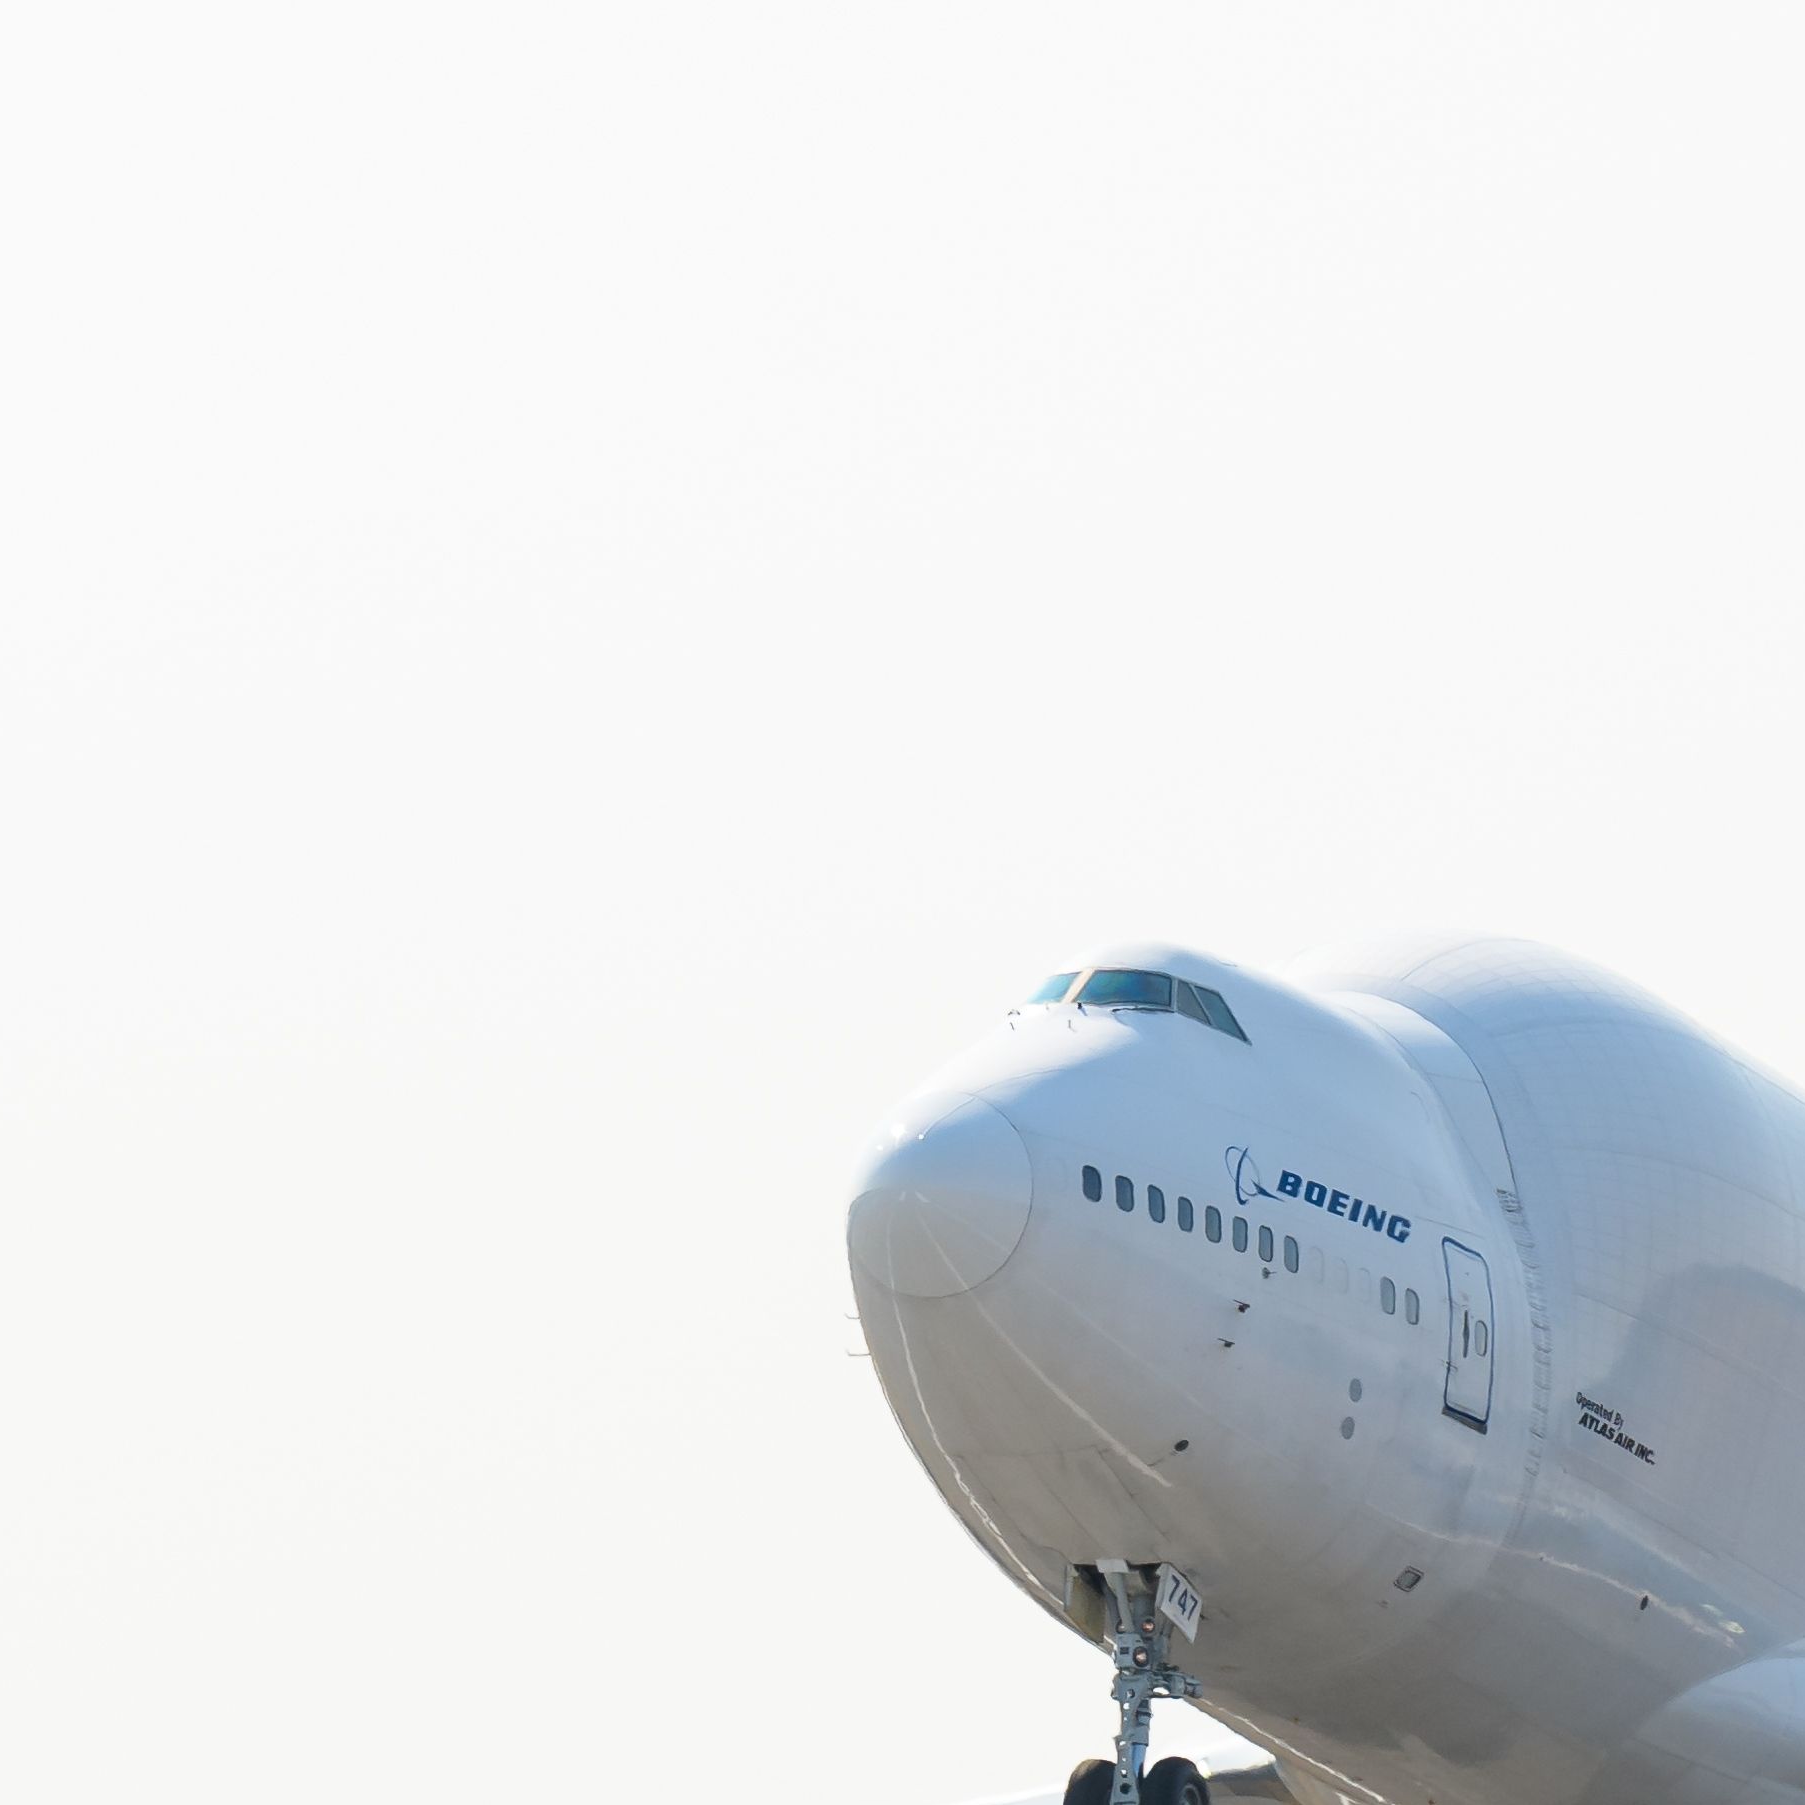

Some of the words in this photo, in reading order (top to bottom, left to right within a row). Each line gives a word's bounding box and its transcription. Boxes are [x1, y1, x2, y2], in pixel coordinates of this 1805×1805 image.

[1277, 1169, 1412, 1244] BOEING
[1576, 1391, 1614, 1422] Operated
[1613, 1411, 1625, 1431] By
[1578, 1412, 1616, 1441] ATLAS
[1614, 1432, 1636, 1454] AIR
[1634, 1443, 1656, 1466] INC.
[1168, 1573, 1199, 1622] 747
